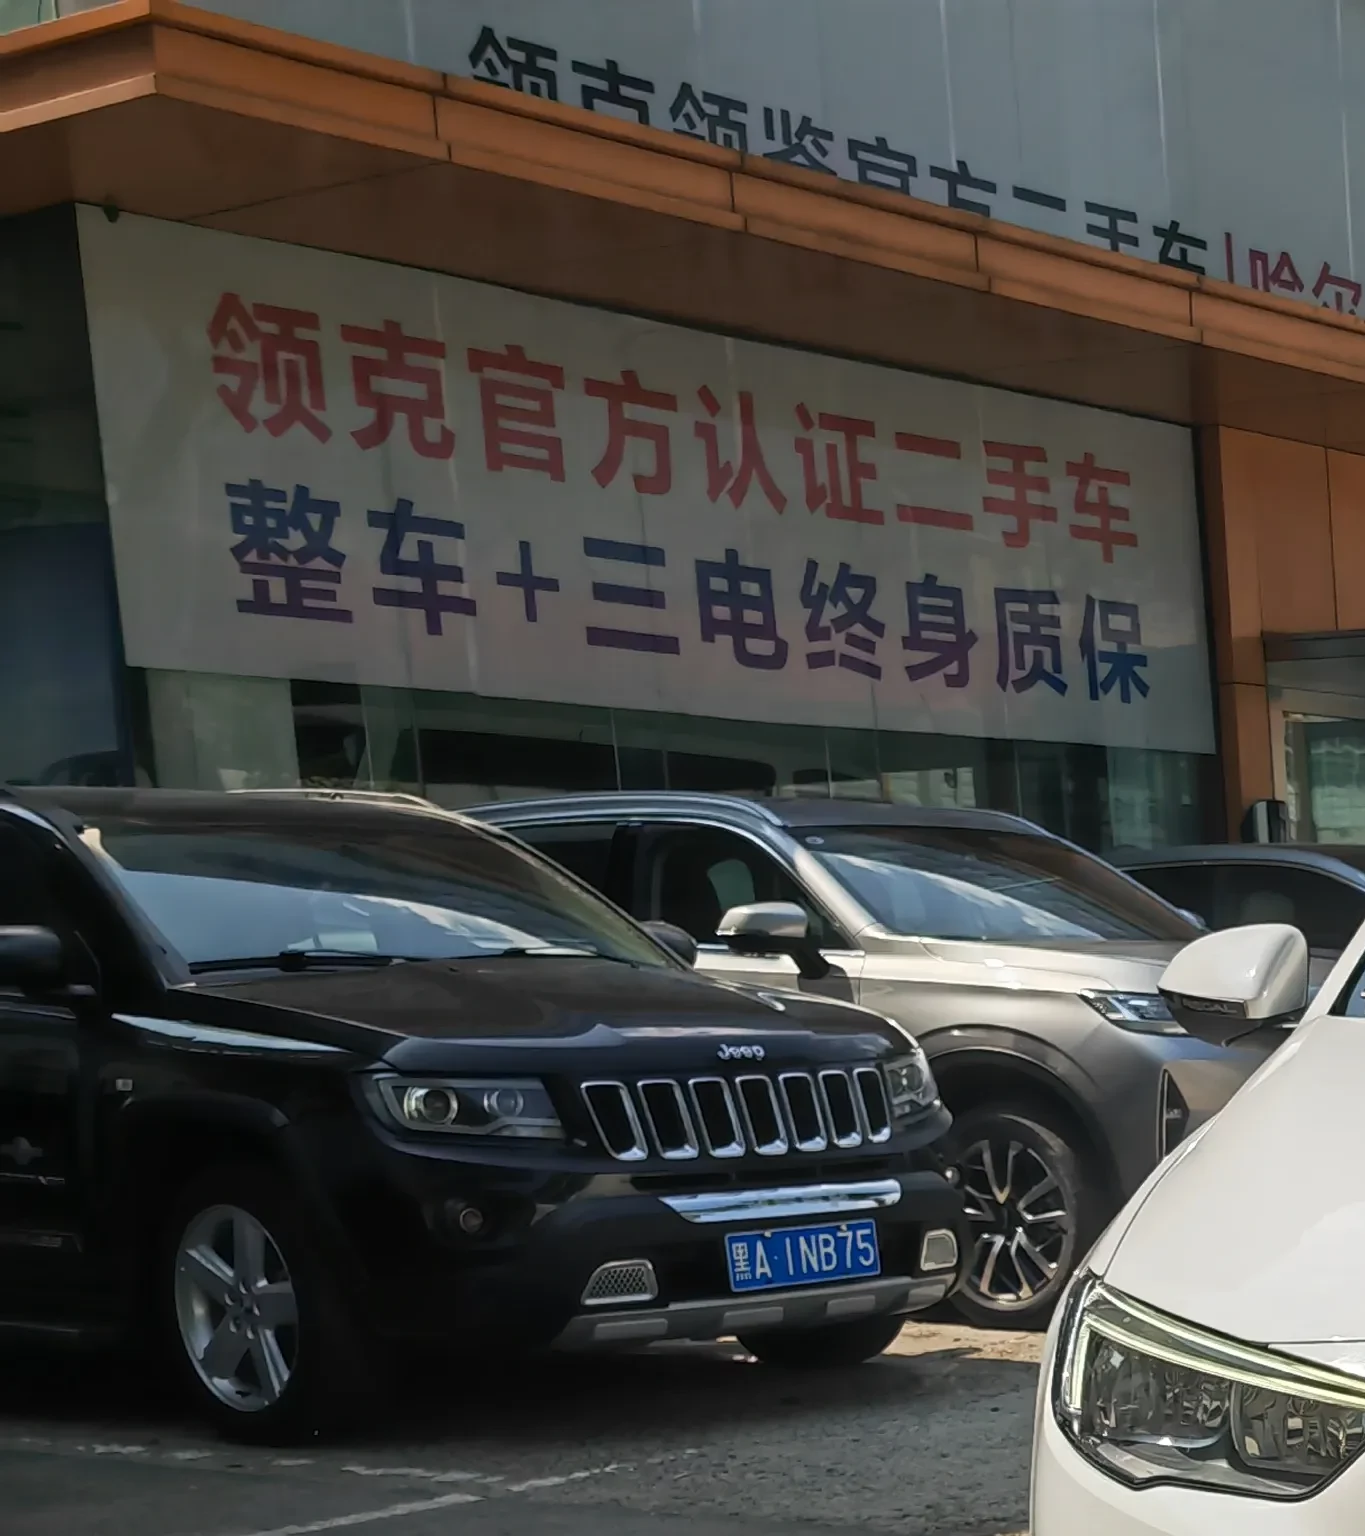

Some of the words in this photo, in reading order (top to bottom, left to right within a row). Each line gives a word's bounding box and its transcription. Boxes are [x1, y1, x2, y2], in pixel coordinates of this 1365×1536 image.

[206, 292, 1138, 563] 领克官方认证二手车
[225, 479, 1151, 704] 整车+三电终身质保
[717, 1043, 765, 1061] Jeep
